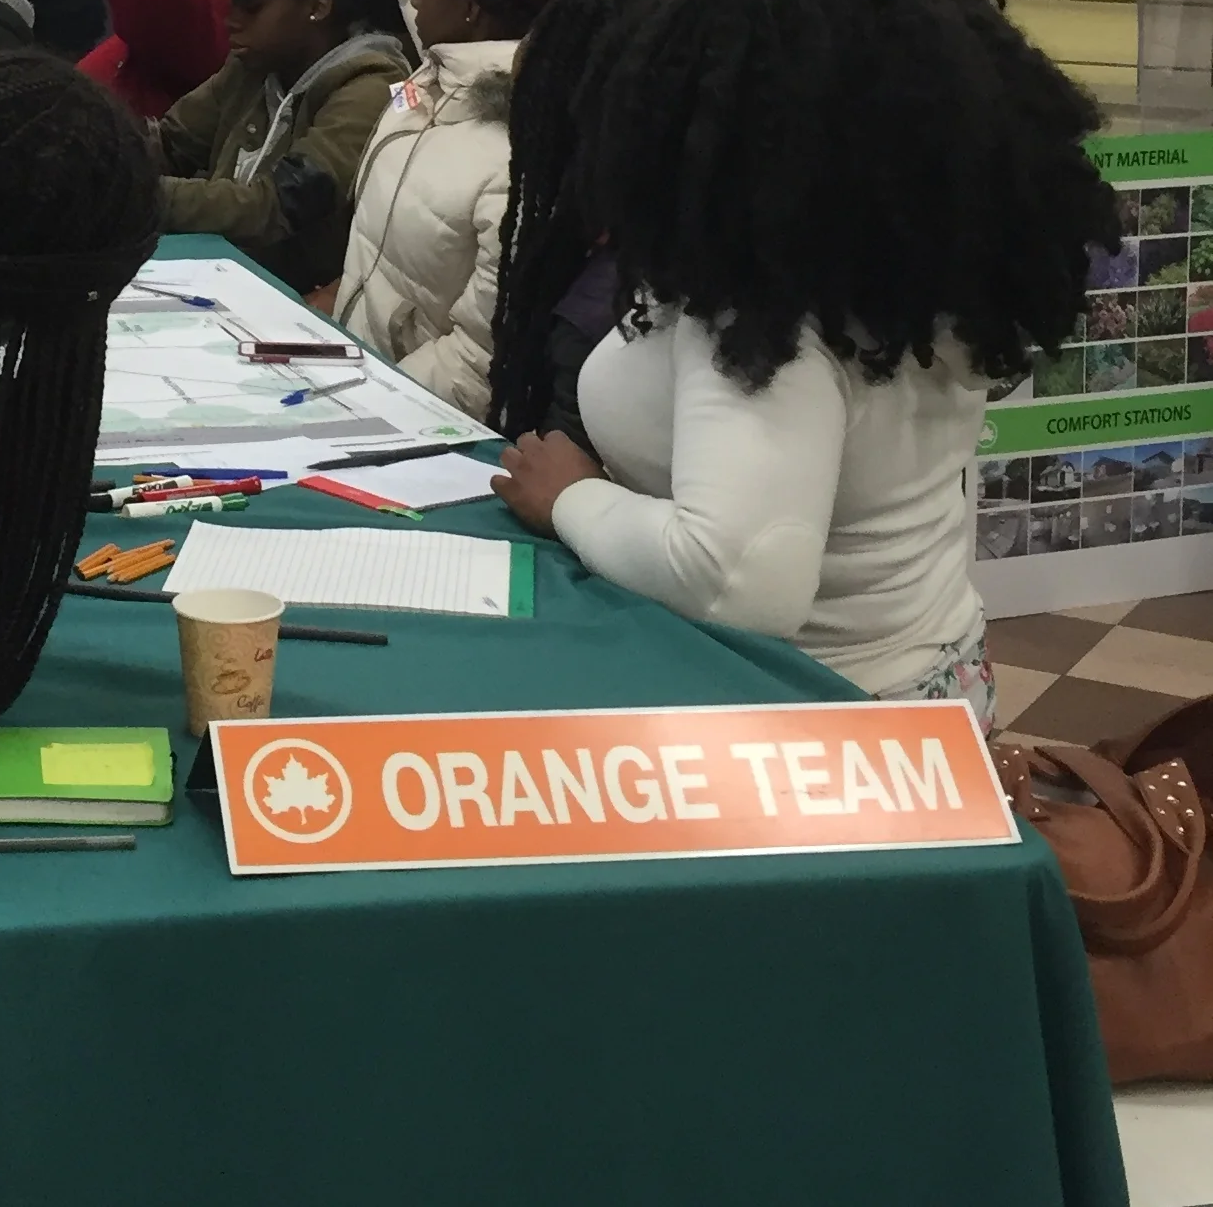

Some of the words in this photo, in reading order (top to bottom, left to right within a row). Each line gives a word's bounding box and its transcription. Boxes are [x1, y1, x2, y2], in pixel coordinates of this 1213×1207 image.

[1116, 149, 1189, 168] MATERIAL
[1046, 412, 1120, 435] COMFORT
[1124, 404, 1192, 427] STATIONS
[383, 743, 720, 832] ORANGE
[730, 738, 965, 818] TEAM
